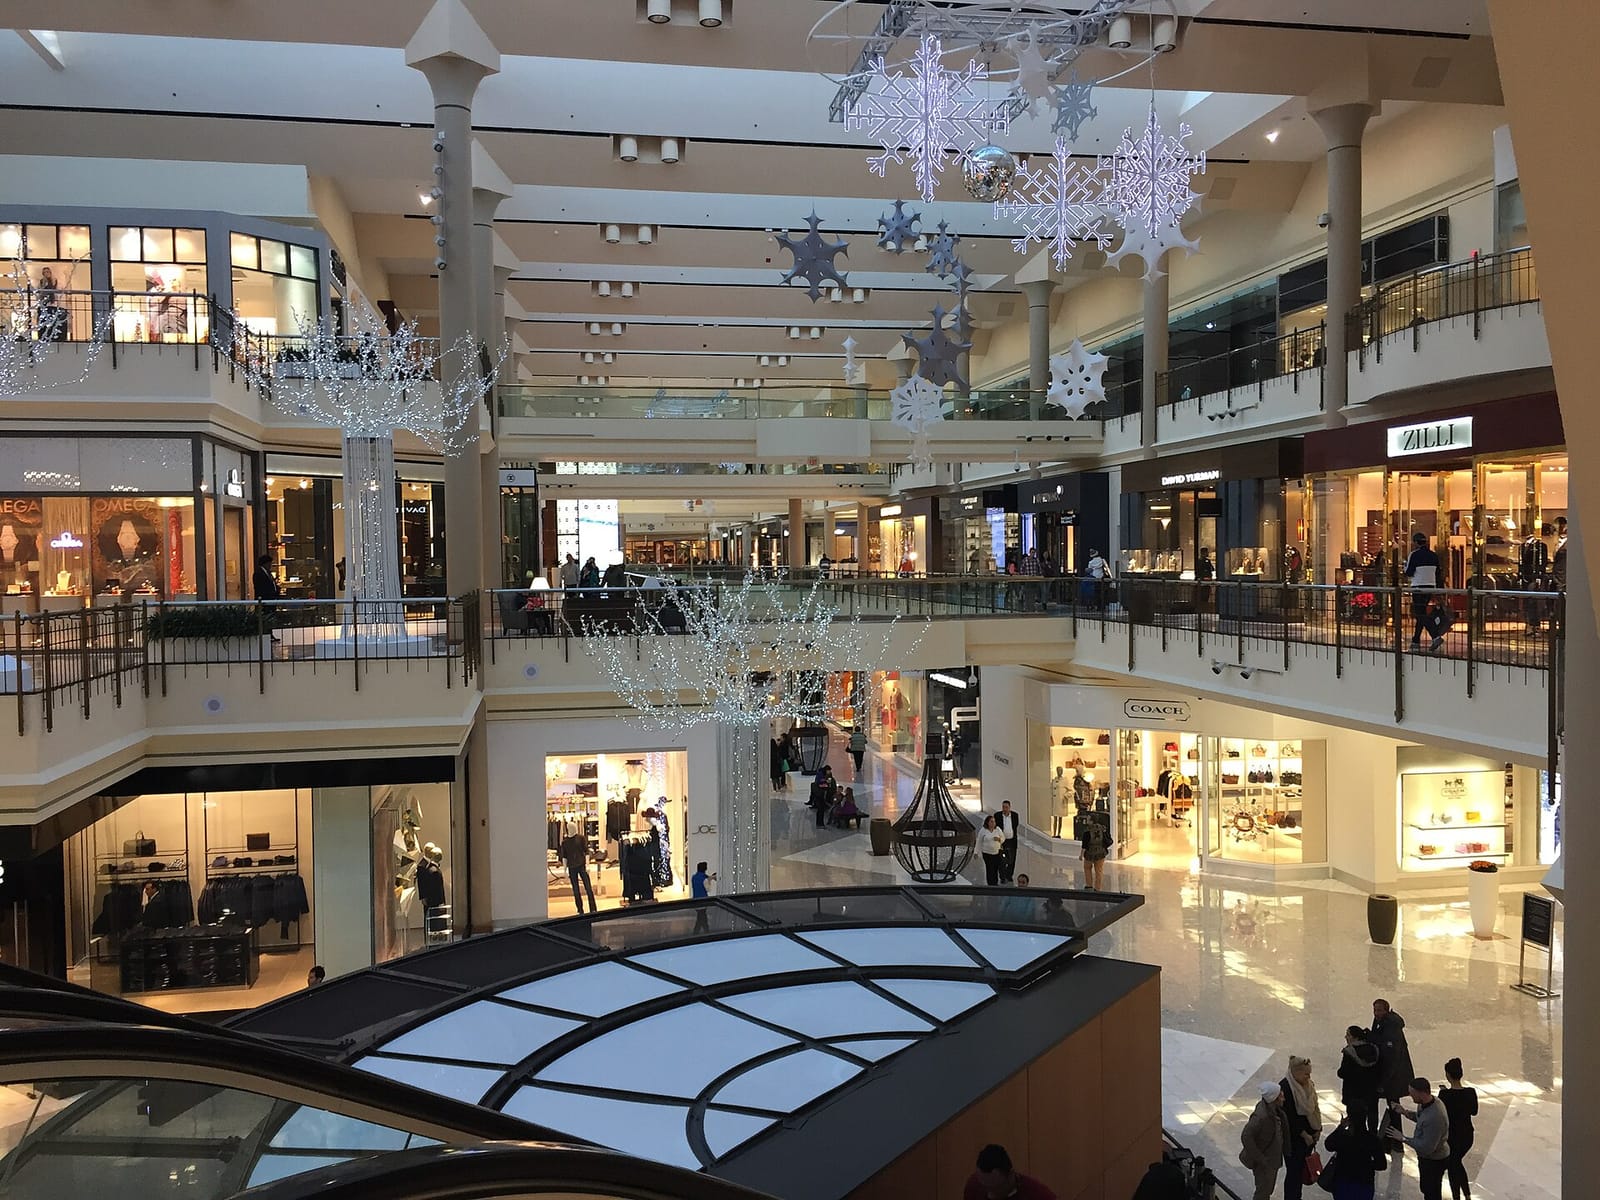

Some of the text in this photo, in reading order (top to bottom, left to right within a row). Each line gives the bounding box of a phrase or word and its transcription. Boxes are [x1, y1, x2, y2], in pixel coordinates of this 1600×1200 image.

[1403, 424, 1454, 451] ZILLI
[1161, 475, 1186, 486] DAVID
[1130, 704, 1185, 715] COACH
[691, 824, 717, 835] JOE
